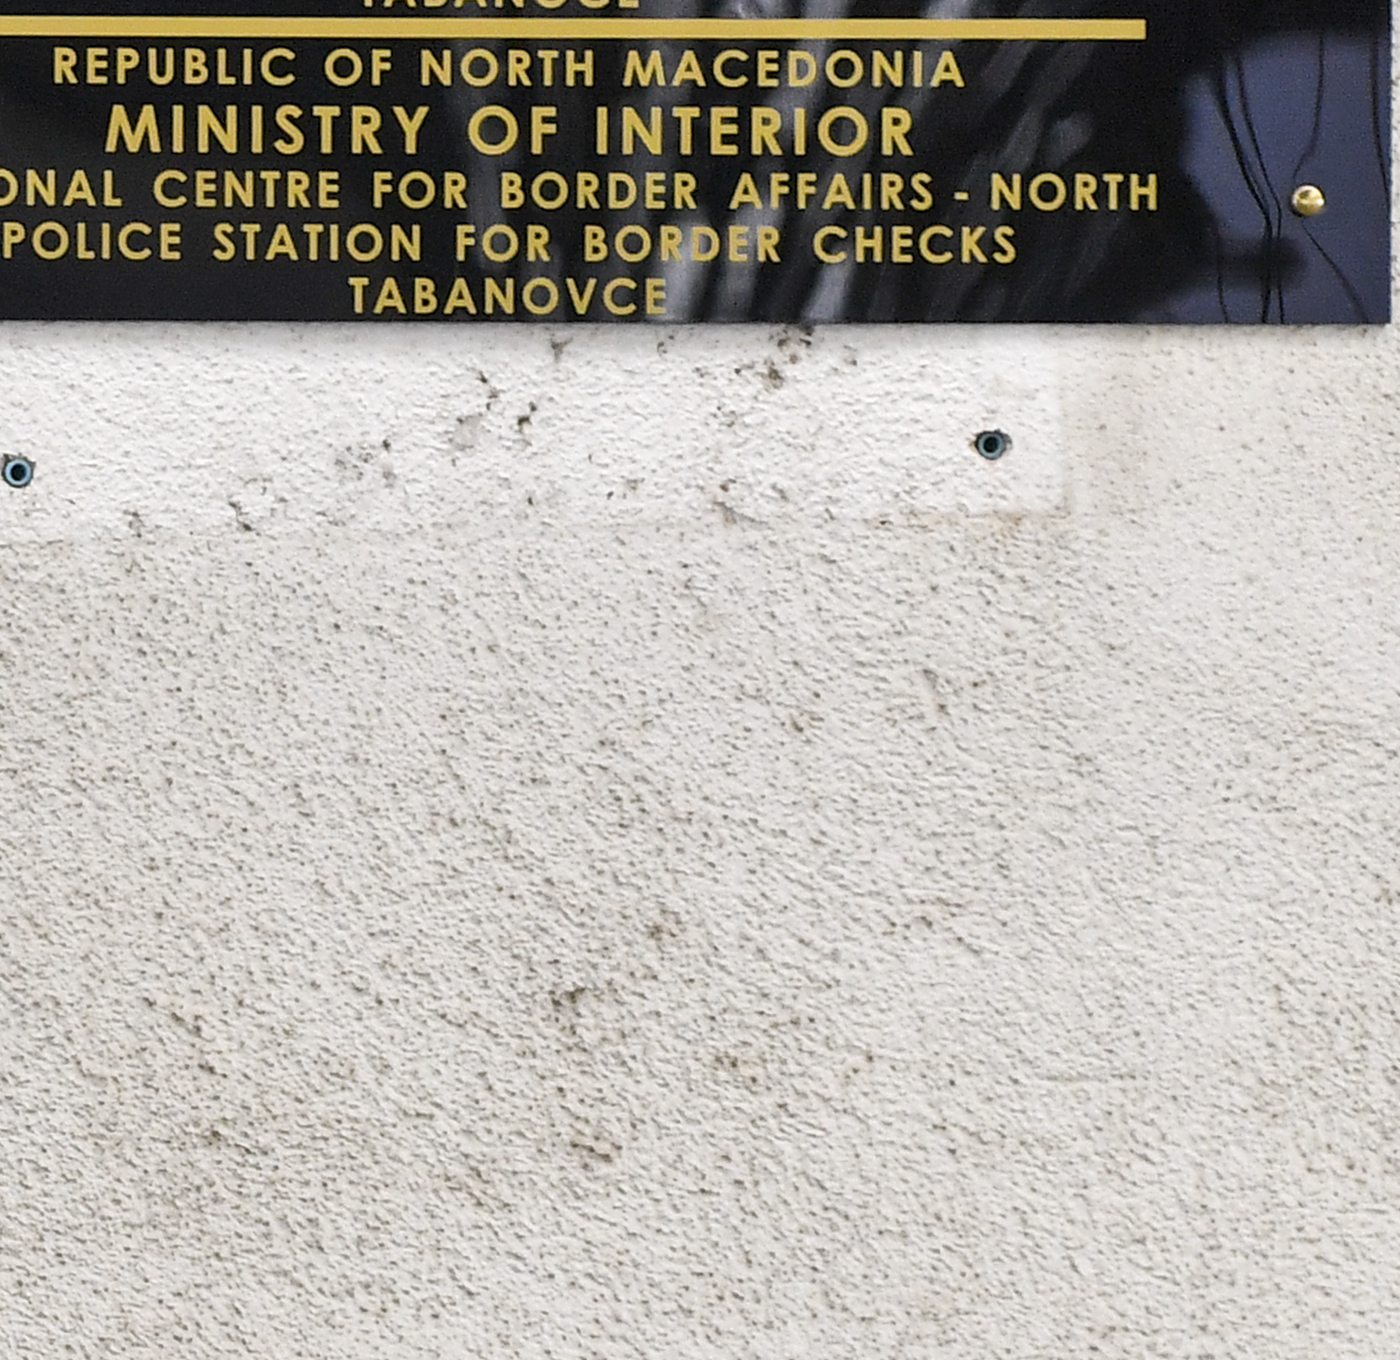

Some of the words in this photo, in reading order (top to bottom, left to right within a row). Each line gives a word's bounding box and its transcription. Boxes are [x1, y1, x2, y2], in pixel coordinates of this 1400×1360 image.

[54, 46, 296, 87] REPUBLIC
[324, 48, 392, 87] OF
[421, 48, 594, 87] NORTH
[623, 49, 966, 88] MACEDONIA
[106, 104, 430, 156] MINISTRY
[467, 105, 557, 156] OF
[596, 106, 915, 157] INTERIOR
[153, 169, 341, 209] CENTRE
[373, 171, 467, 210] FOR
[501, 171, 698, 210] BORDER
[730, 172, 934, 211] AFFAIRS
[991, 172, 1158, 211] NORTH
[3, 221, 182, 261] POLICE
[213, 222, 422, 262] STATION
[456, 224, 551, 263] FOR
[584, 224, 782, 264] BORDER
[813, 225, 1017, 265] CHECKS
[348, 276, 666, 316] TABANOVCE
